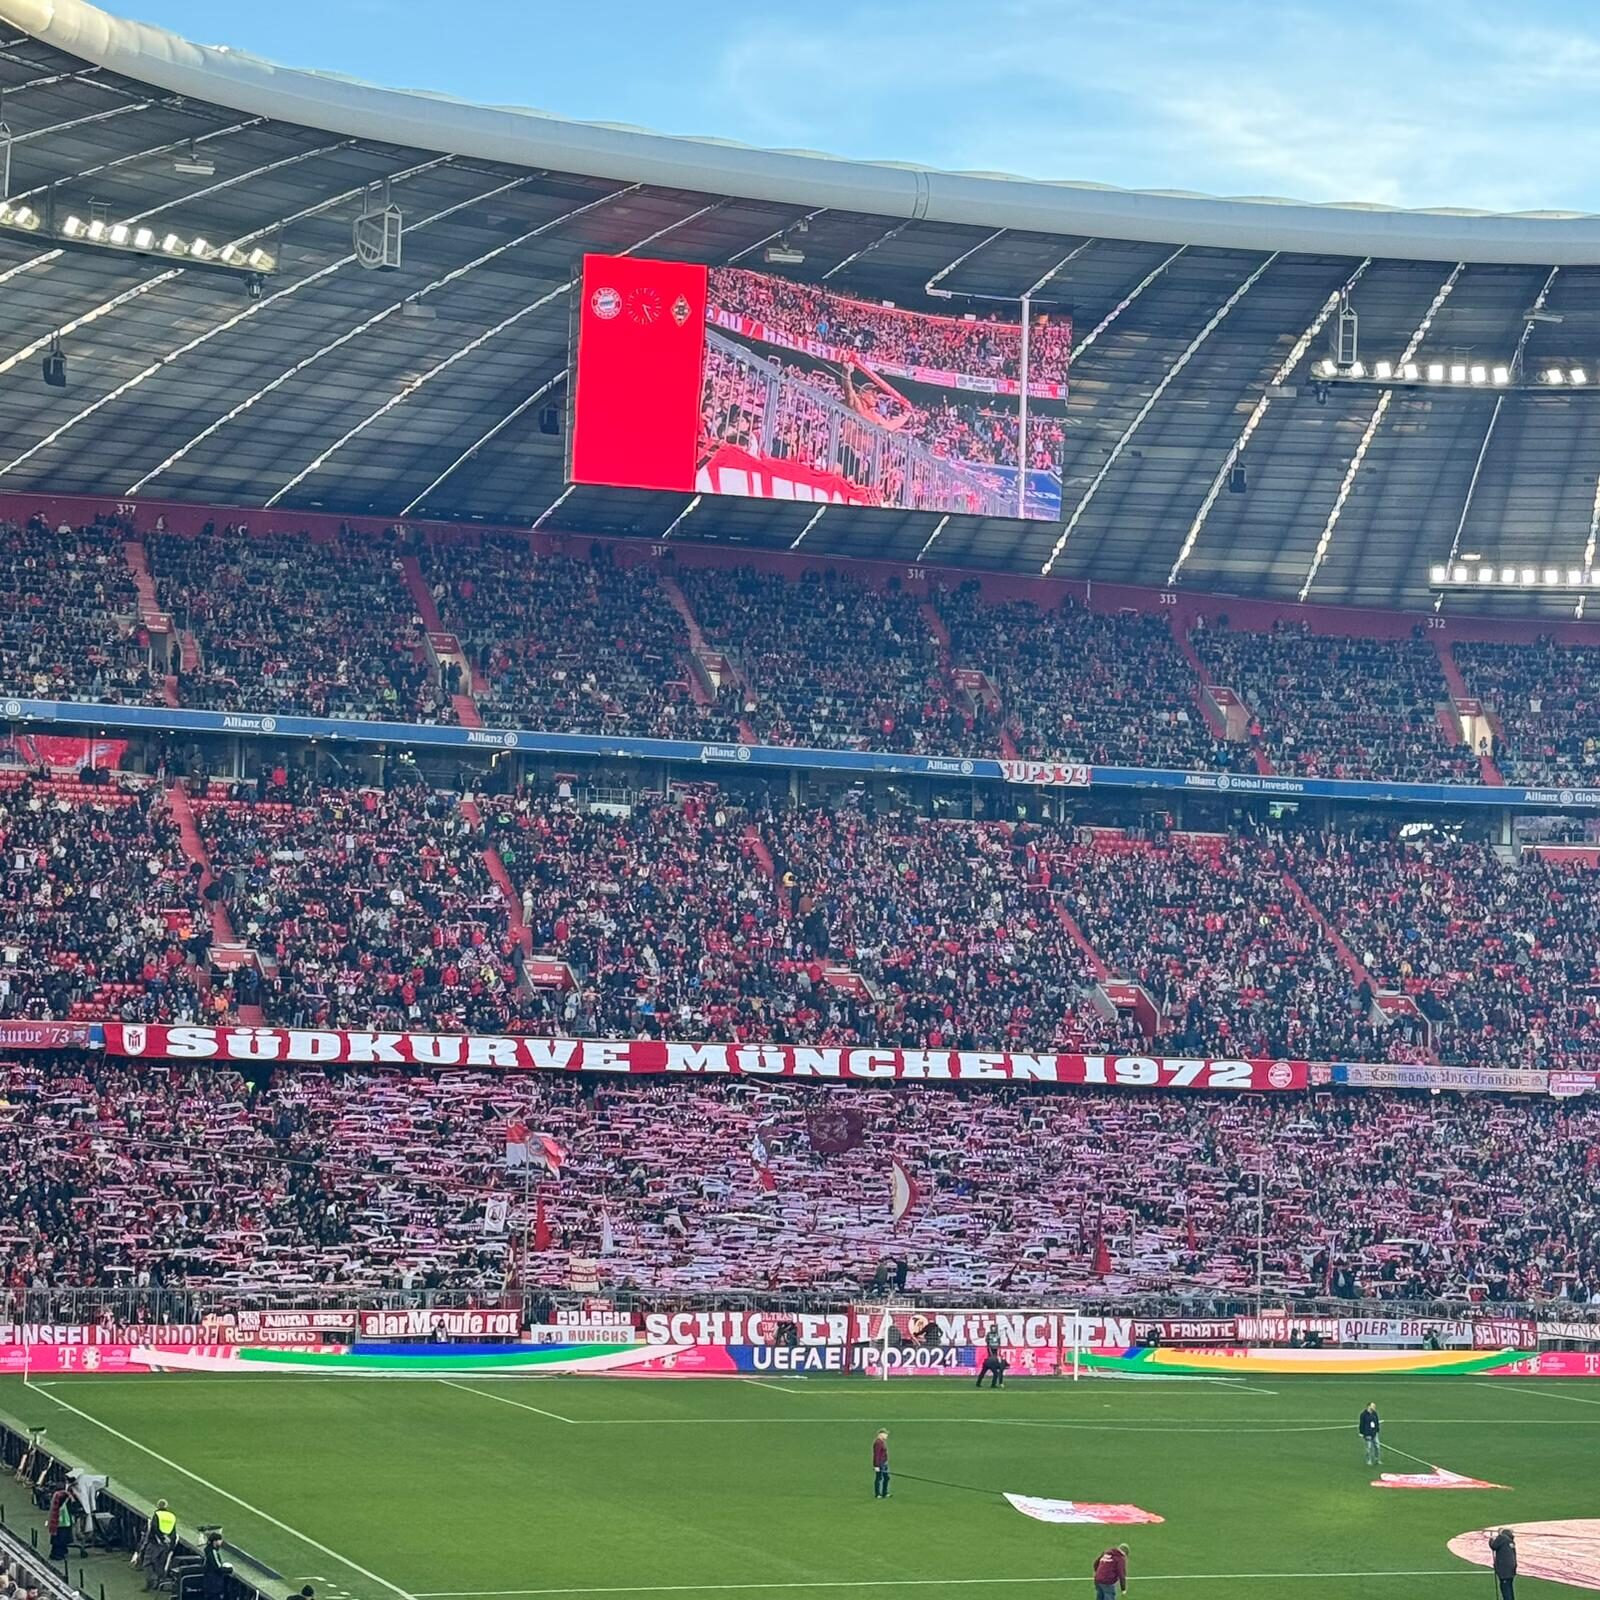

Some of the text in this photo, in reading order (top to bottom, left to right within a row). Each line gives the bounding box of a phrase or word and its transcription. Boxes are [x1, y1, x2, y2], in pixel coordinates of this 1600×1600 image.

[907, 569, 926, 579] 314
[1159, 594, 1177, 607] 313
[1427, 618, 1446, 629] 312
[223, 716, 260, 729] Allianz
[467, 732, 503, 743] Allianz
[701, 746, 735, 758] Allianz
[927, 759, 959, 771] Allianz
[1062, 764, 1089, 784] 94
[1185, 774, 1304, 791] Allianz Global Investors
[1524, 791, 1558, 802] Allianz
[166, 1027, 630, 1072] SÜDKURVE
[665, 1043, 1058, 1082] MÜNCHEN
[1084, 1057, 1253, 1088] 1972
[487, 1314, 518, 1336] rot
[1345, 1321, 1466, 1337] ADLER BRETTEN
